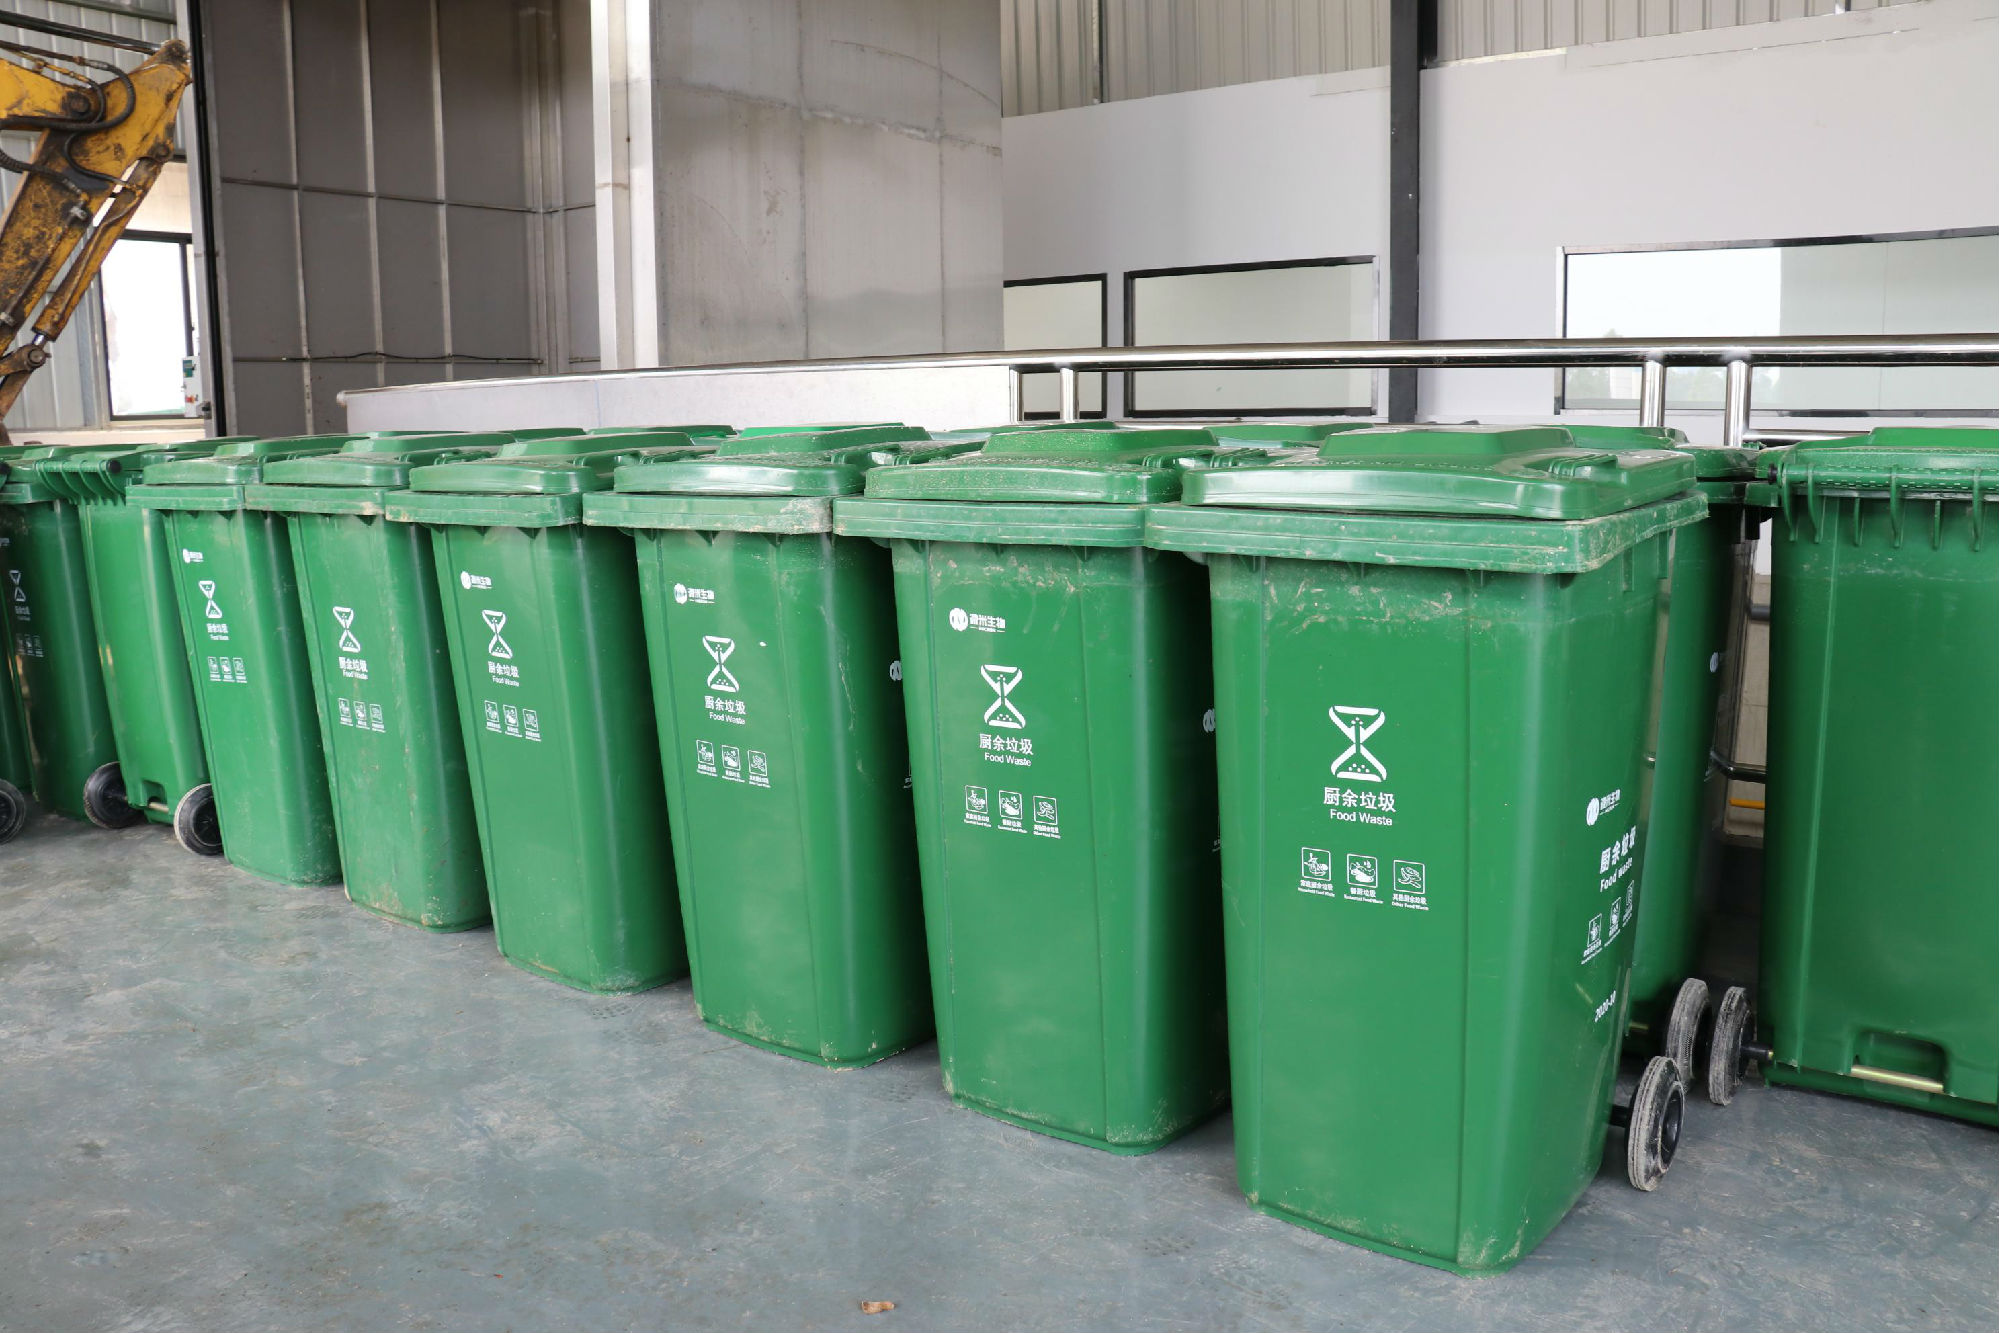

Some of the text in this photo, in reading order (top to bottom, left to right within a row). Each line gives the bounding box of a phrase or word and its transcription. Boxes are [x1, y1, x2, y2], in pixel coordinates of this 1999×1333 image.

[704, 695, 747, 715] 厨余垃圾
[709, 711, 746, 725] Food Waste
[979, 733, 1034, 756] 厨余垃圾
[984, 751, 1032, 767] Food Waste
[1323, 786, 1397, 813] 厨余垃圾
[1330, 808, 1393, 826] Food Waste
[1600, 868, 1618, 893] Food
